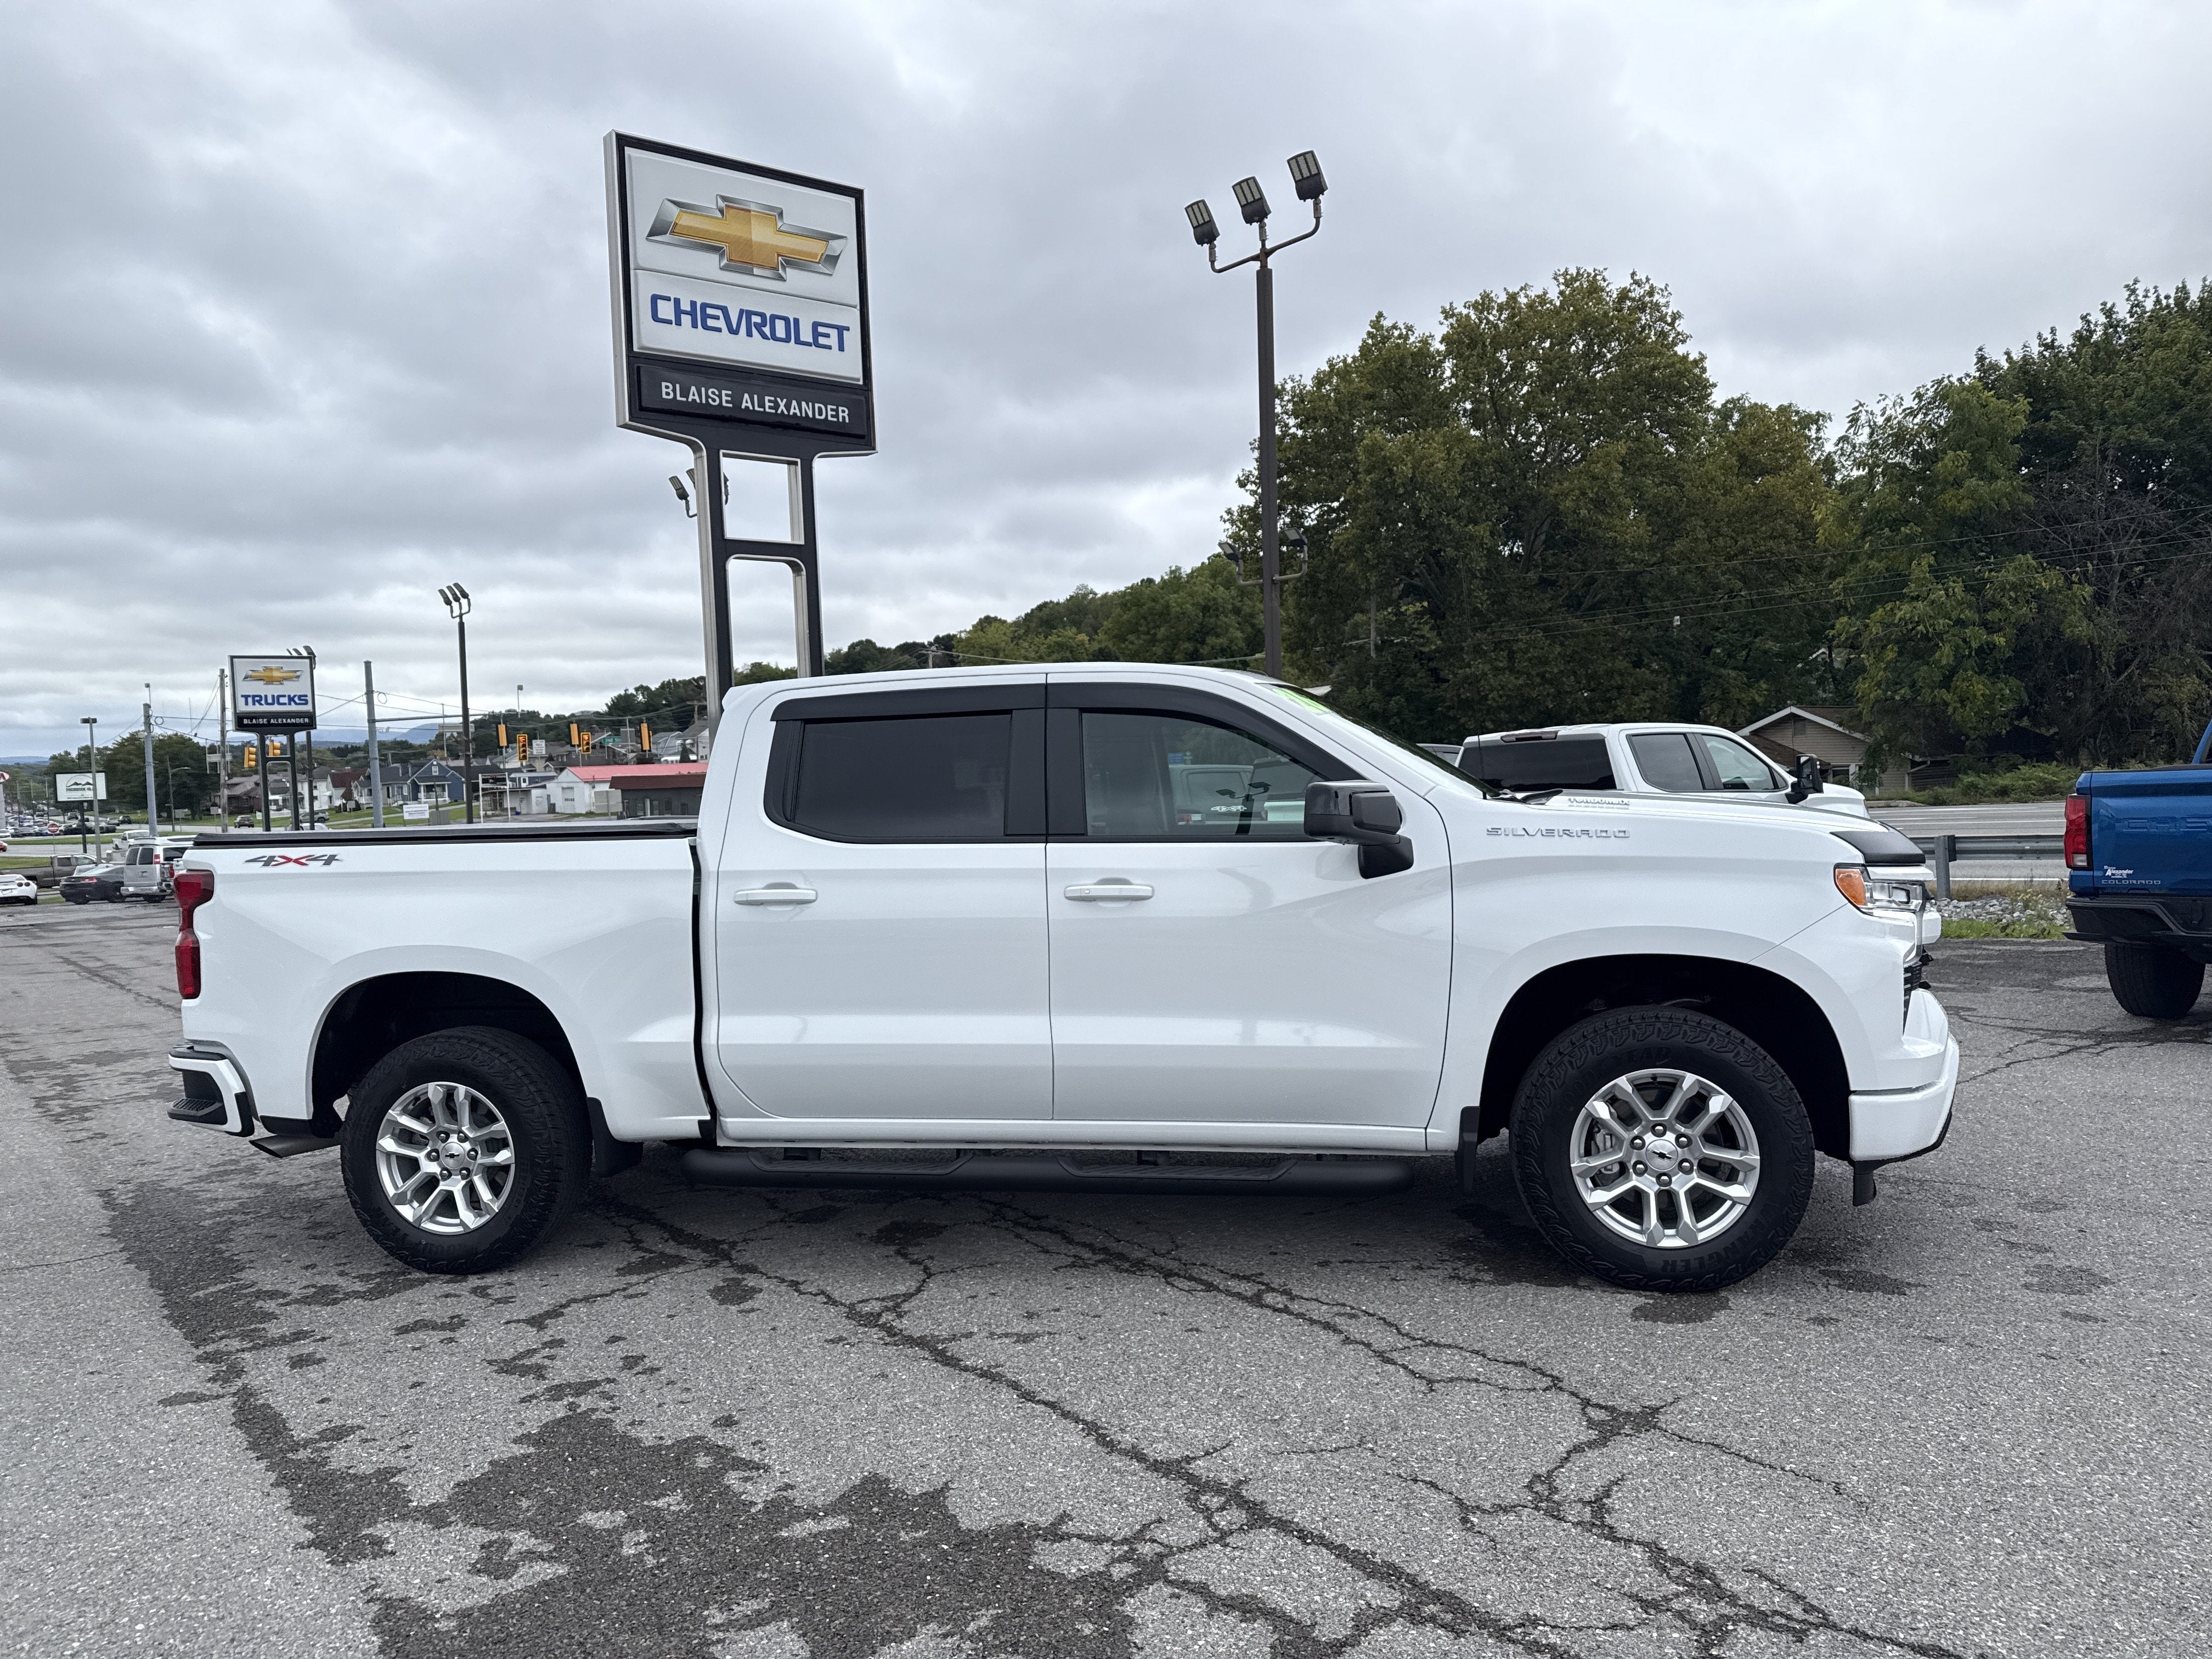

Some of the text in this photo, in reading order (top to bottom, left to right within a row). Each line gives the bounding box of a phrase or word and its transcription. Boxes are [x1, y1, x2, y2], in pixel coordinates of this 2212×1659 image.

[651, 293, 850, 352] CHEVROLET
[661, 381, 850, 424] BLAISE ALEXANDER
[240, 694, 309, 706] TRUCKS
[1486, 827, 1630, 838] SILVERADO
